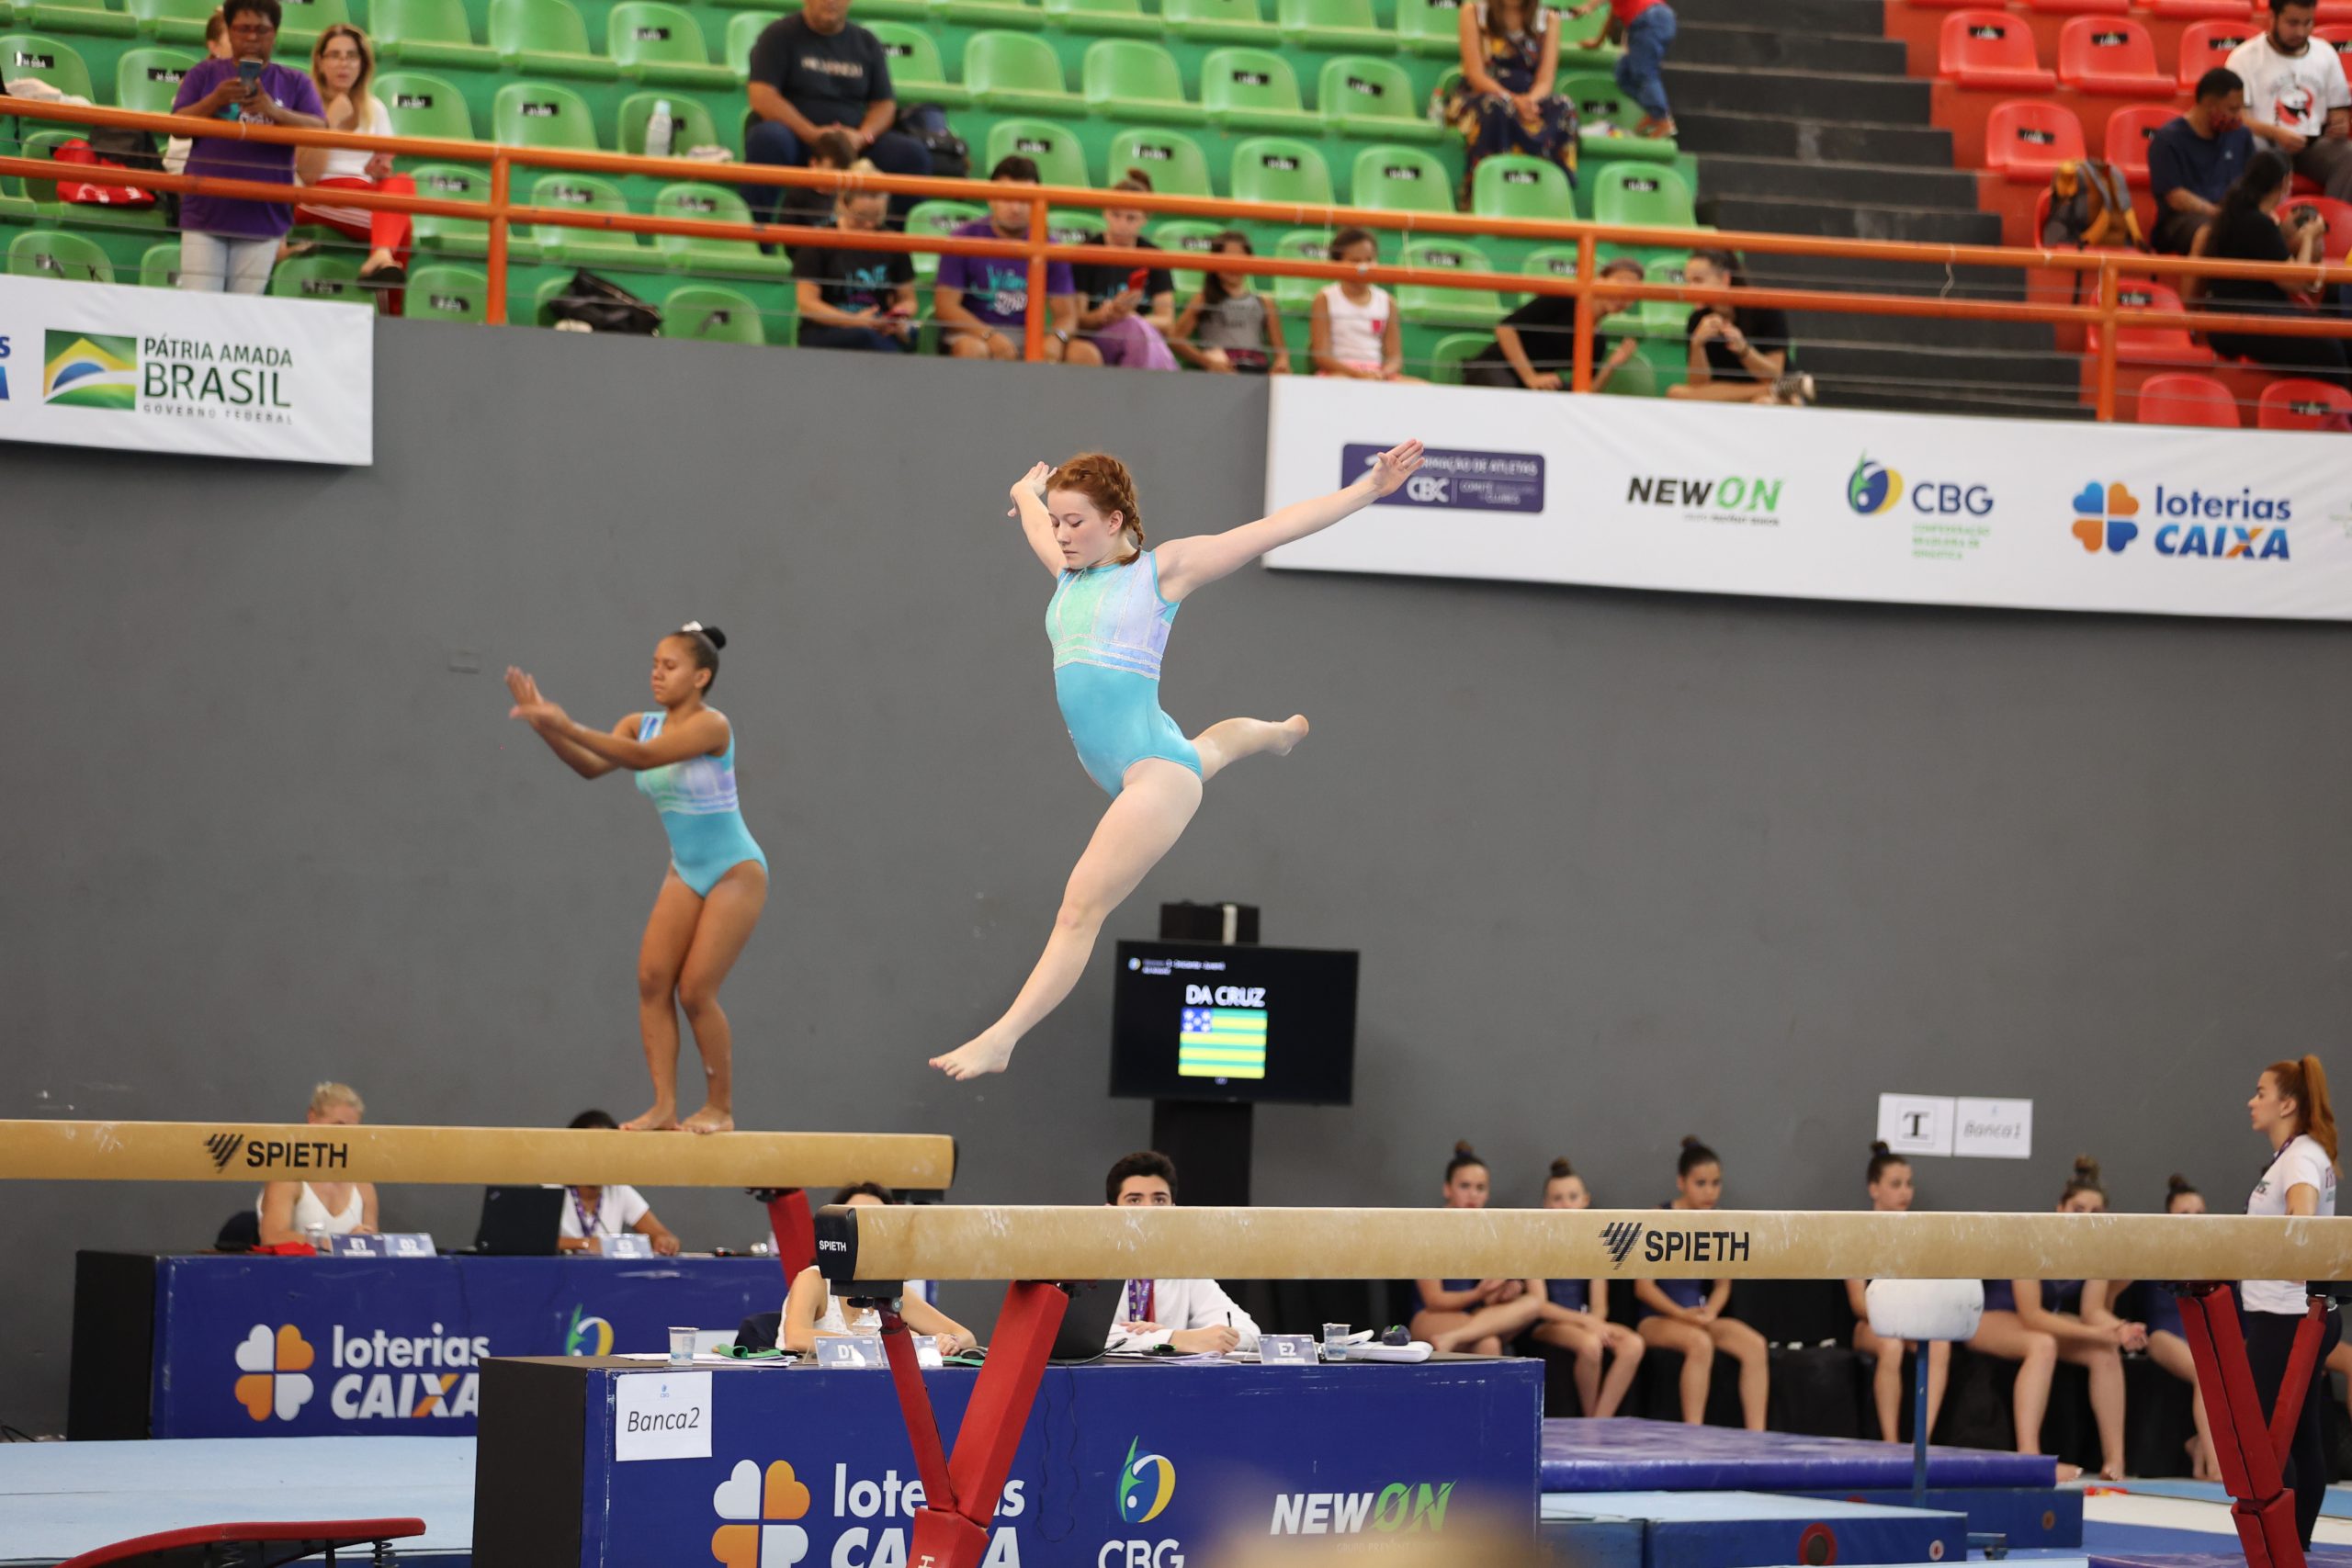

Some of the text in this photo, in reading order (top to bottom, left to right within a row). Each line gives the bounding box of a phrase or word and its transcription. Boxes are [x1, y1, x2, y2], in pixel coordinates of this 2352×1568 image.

[144, 333, 294, 367] PÁTRIA AMADA
[144, 362, 292, 409] BRASIL
[143, 404, 294, 425] GOVERNO FEDERAL
[1911, 482, 1994, 515] CBG
[2154, 485, 2291, 520] loterias
[2154, 524, 2290, 559] CAIXA
[1185, 984, 1266, 1008] DA CRUZ
[246, 1141, 348, 1168] SPIETH
[819, 1240, 847, 1252] SPIETH
[1645, 1231, 1749, 1262] SPIETH
[333, 1322, 490, 1368] loterias
[1278, 1342, 1296, 1357] E2
[331, 1373, 480, 1420] CAIXA
[628, 1406, 700, 1432] Banca2
[831, 1527, 1021, 1568] CAA
[1097, 1539, 1185, 1568] CBG
